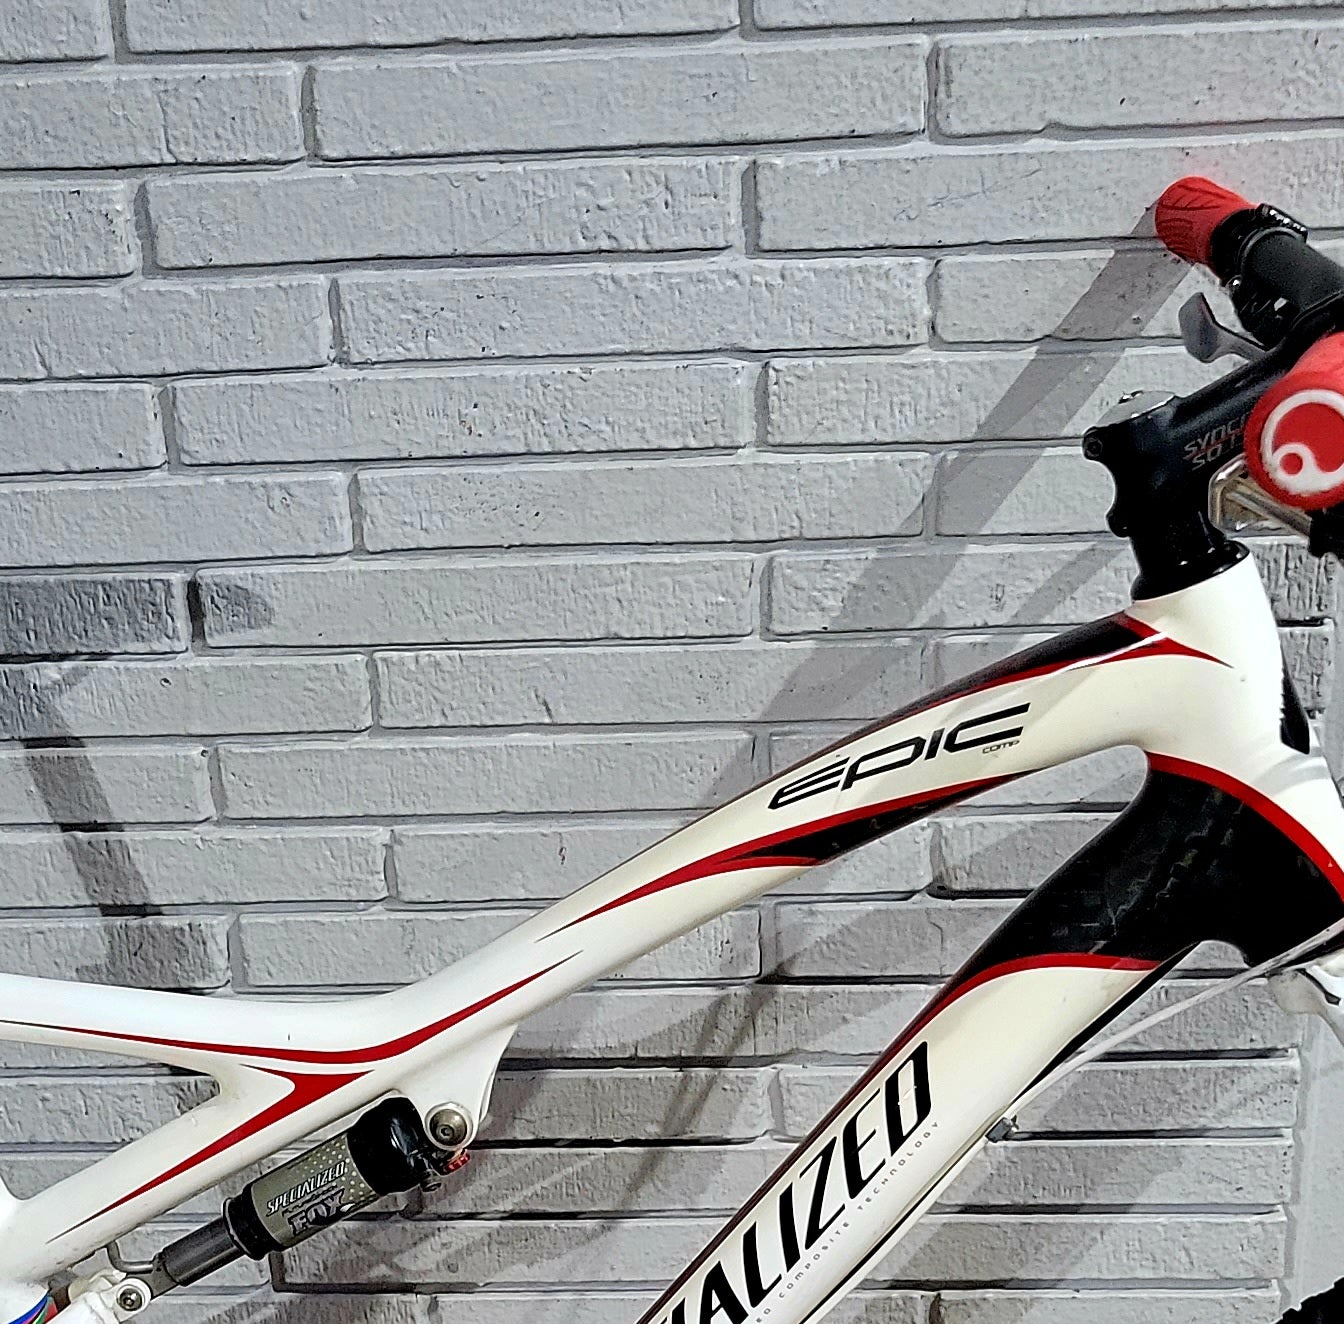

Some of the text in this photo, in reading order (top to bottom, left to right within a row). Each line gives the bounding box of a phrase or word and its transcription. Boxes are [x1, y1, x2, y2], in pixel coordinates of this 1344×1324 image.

[768, 702, 1031, 810] EPIC
[266, 1161, 346, 1217] SPECIALIZED
[779, 1222, 849, 1298] COMPOSITE
[857, 1122, 938, 1211] TECHNOLOGY
